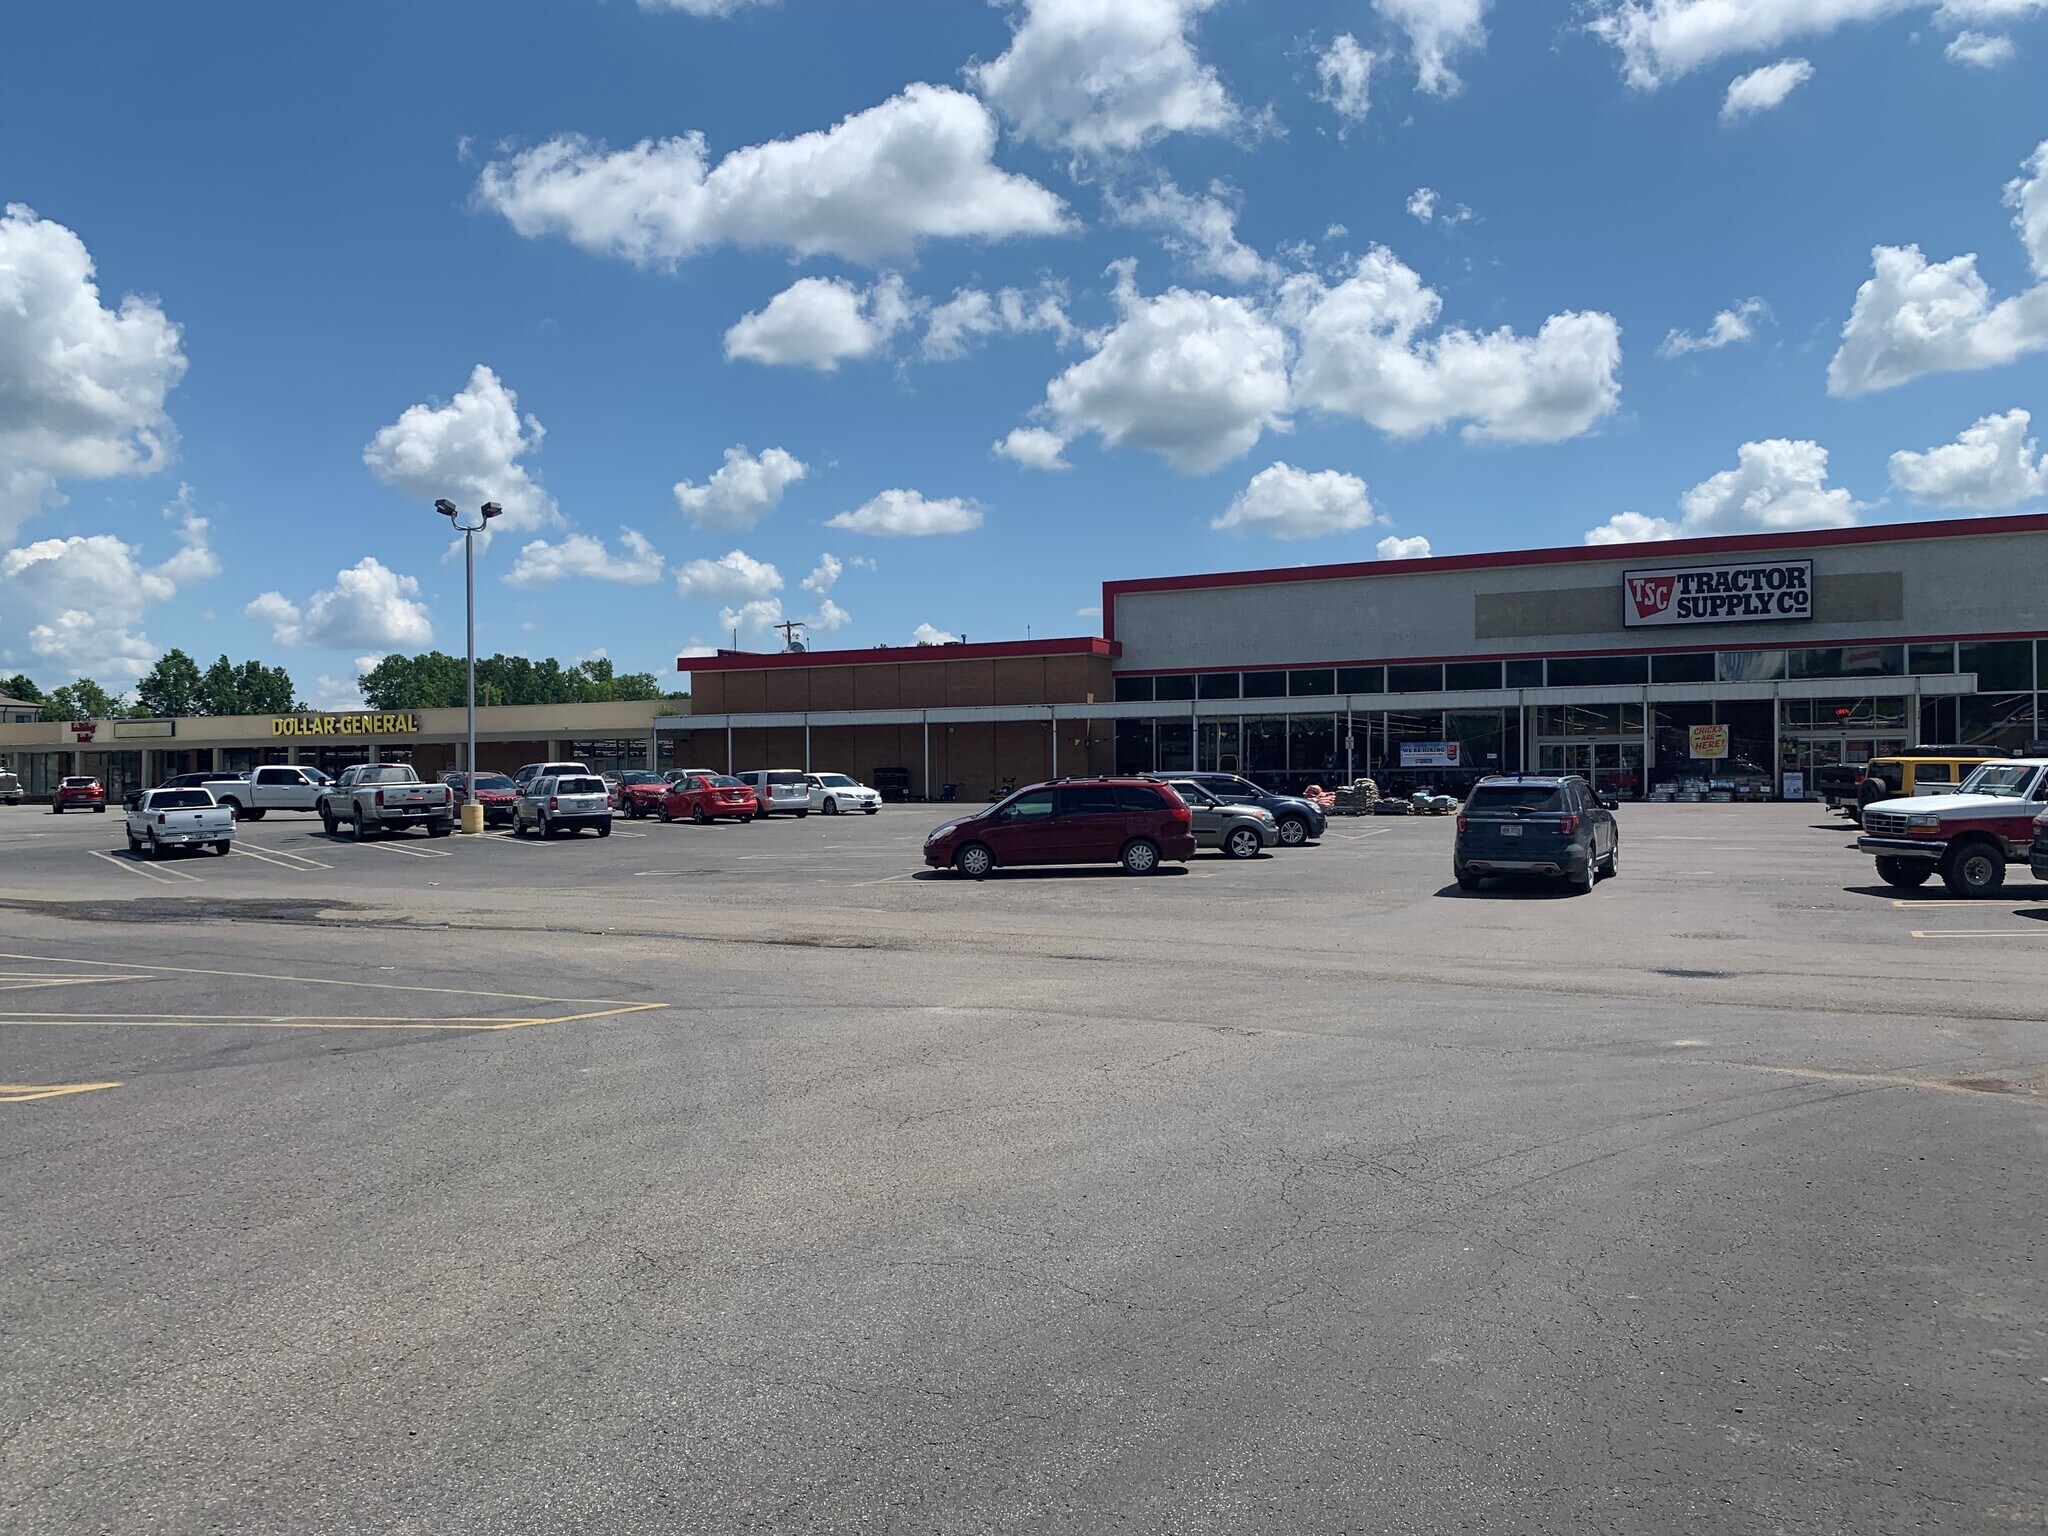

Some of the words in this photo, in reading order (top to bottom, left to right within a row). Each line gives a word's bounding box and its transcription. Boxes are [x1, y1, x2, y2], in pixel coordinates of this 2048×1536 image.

[1676, 566, 1807, 595] TRACTOR
[1632, 579, 1668, 609] TSC
[1676, 593, 1774, 619] SUPPLY
[271, 715, 337, 736] DOLLAR
[339, 713, 418, 735] GENERAL
[1694, 725, 1724, 736] CHICKS
[1695, 739, 1726, 750] HERE!
[1701, 733, 1716, 741] ARE
